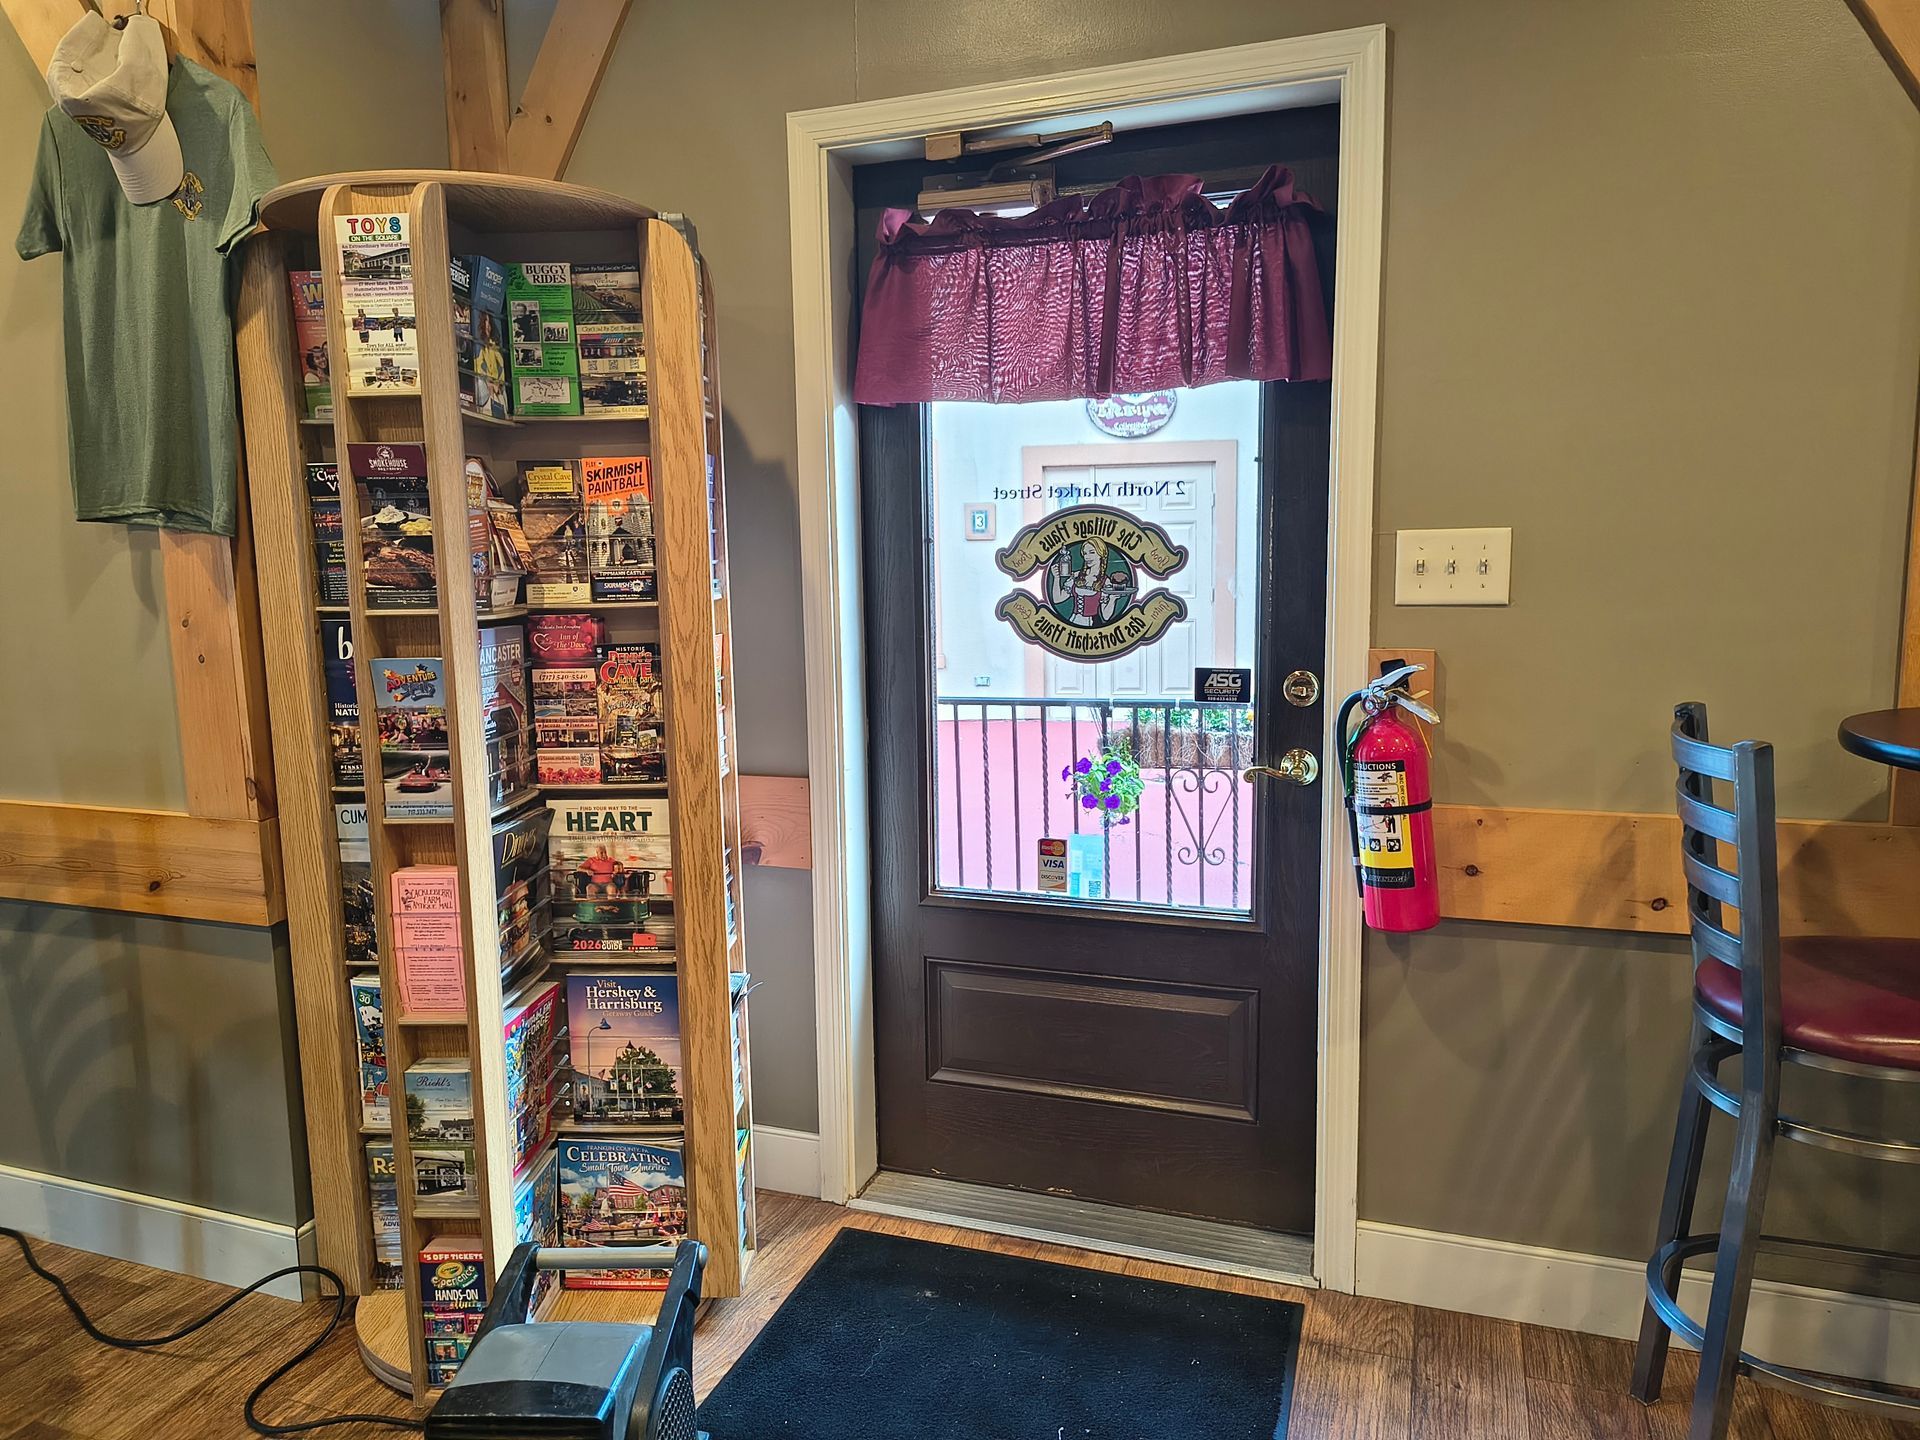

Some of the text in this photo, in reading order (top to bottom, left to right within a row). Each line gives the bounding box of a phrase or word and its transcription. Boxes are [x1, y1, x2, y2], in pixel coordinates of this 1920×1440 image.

[347, 216, 402, 234] TOYS
[525, 264, 567, 276] BUGGY
[532, 274, 567, 284] RIDES
[368, 458, 409, 469] SMOKEHOUSE
[527, 471, 571, 483] Crystal Cave
[586, 461, 643, 483] SKIRMISH
[588, 474, 645, 496] PAINTBALL
[572, 631, 579, 642] of
[480, 643, 521, 665] ANCASTER
[600, 660, 653, 684] CAVE
[386, 671, 437, 693] ADVENTURE
[1204, 673, 1242, 688] ASG
[335, 708, 360, 717] NATU
[1354, 762, 1397, 771] RUCTIONS
[340, 809, 368, 825] CUM
[566, 811, 653, 832] HEART
[1042, 859, 1065, 869] VISA
[572, 940, 601, 950] 2026
[596, 979, 617, 988] Visit
[585, 985, 657, 1002] Hershey &
[586, 998, 663, 1013] Harrisburg
[602, 1010, 633, 1018] Getaway
[527, 1011, 551, 1040] FORGE
[416, 1075, 451, 1087] Riehl's
[566, 1146, 671, 1166] CELEBRATING
[580, 1163, 667, 1173] Small Town America
[423, 1253, 432, 1261] $5
[432, 1253, 450, 1261] OFF
[434, 1288, 479, 1301] HANDS-ON
